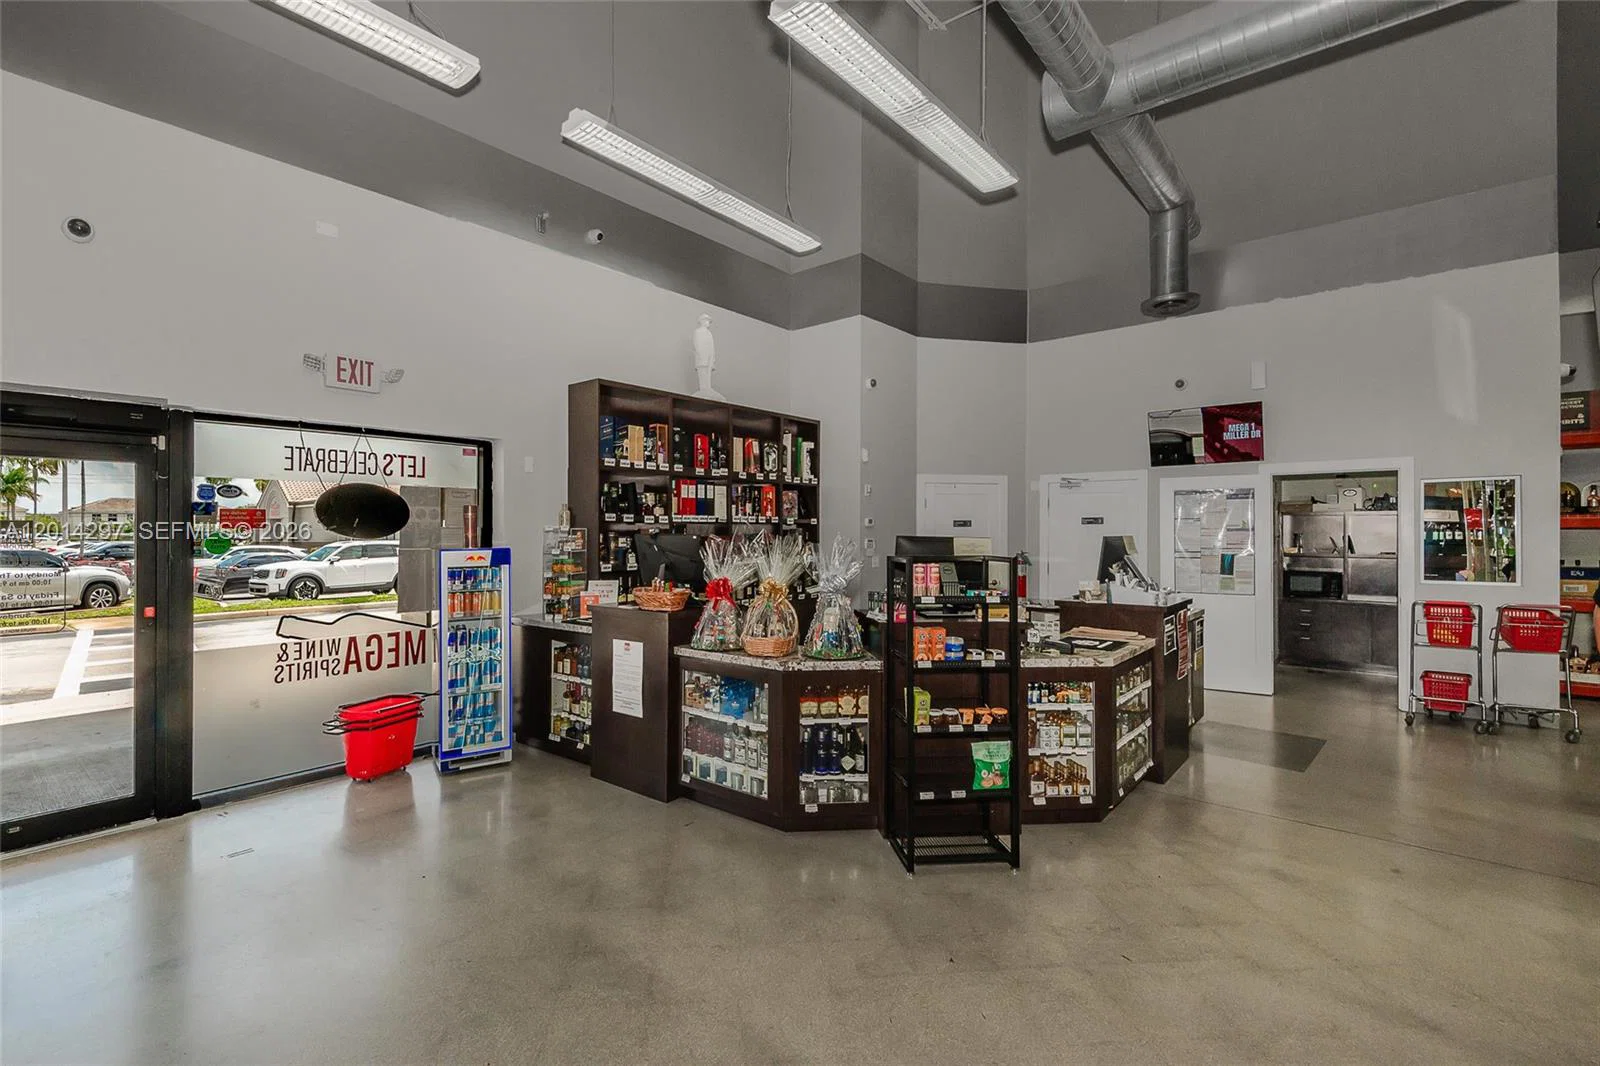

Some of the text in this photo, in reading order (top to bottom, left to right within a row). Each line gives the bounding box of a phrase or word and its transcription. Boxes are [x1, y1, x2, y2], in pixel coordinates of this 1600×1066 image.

[336, 356, 374, 387] EXIT
[1228, 422, 1256, 432] MEGA 1
[1223, 430, 1261, 441] MILLER DR
